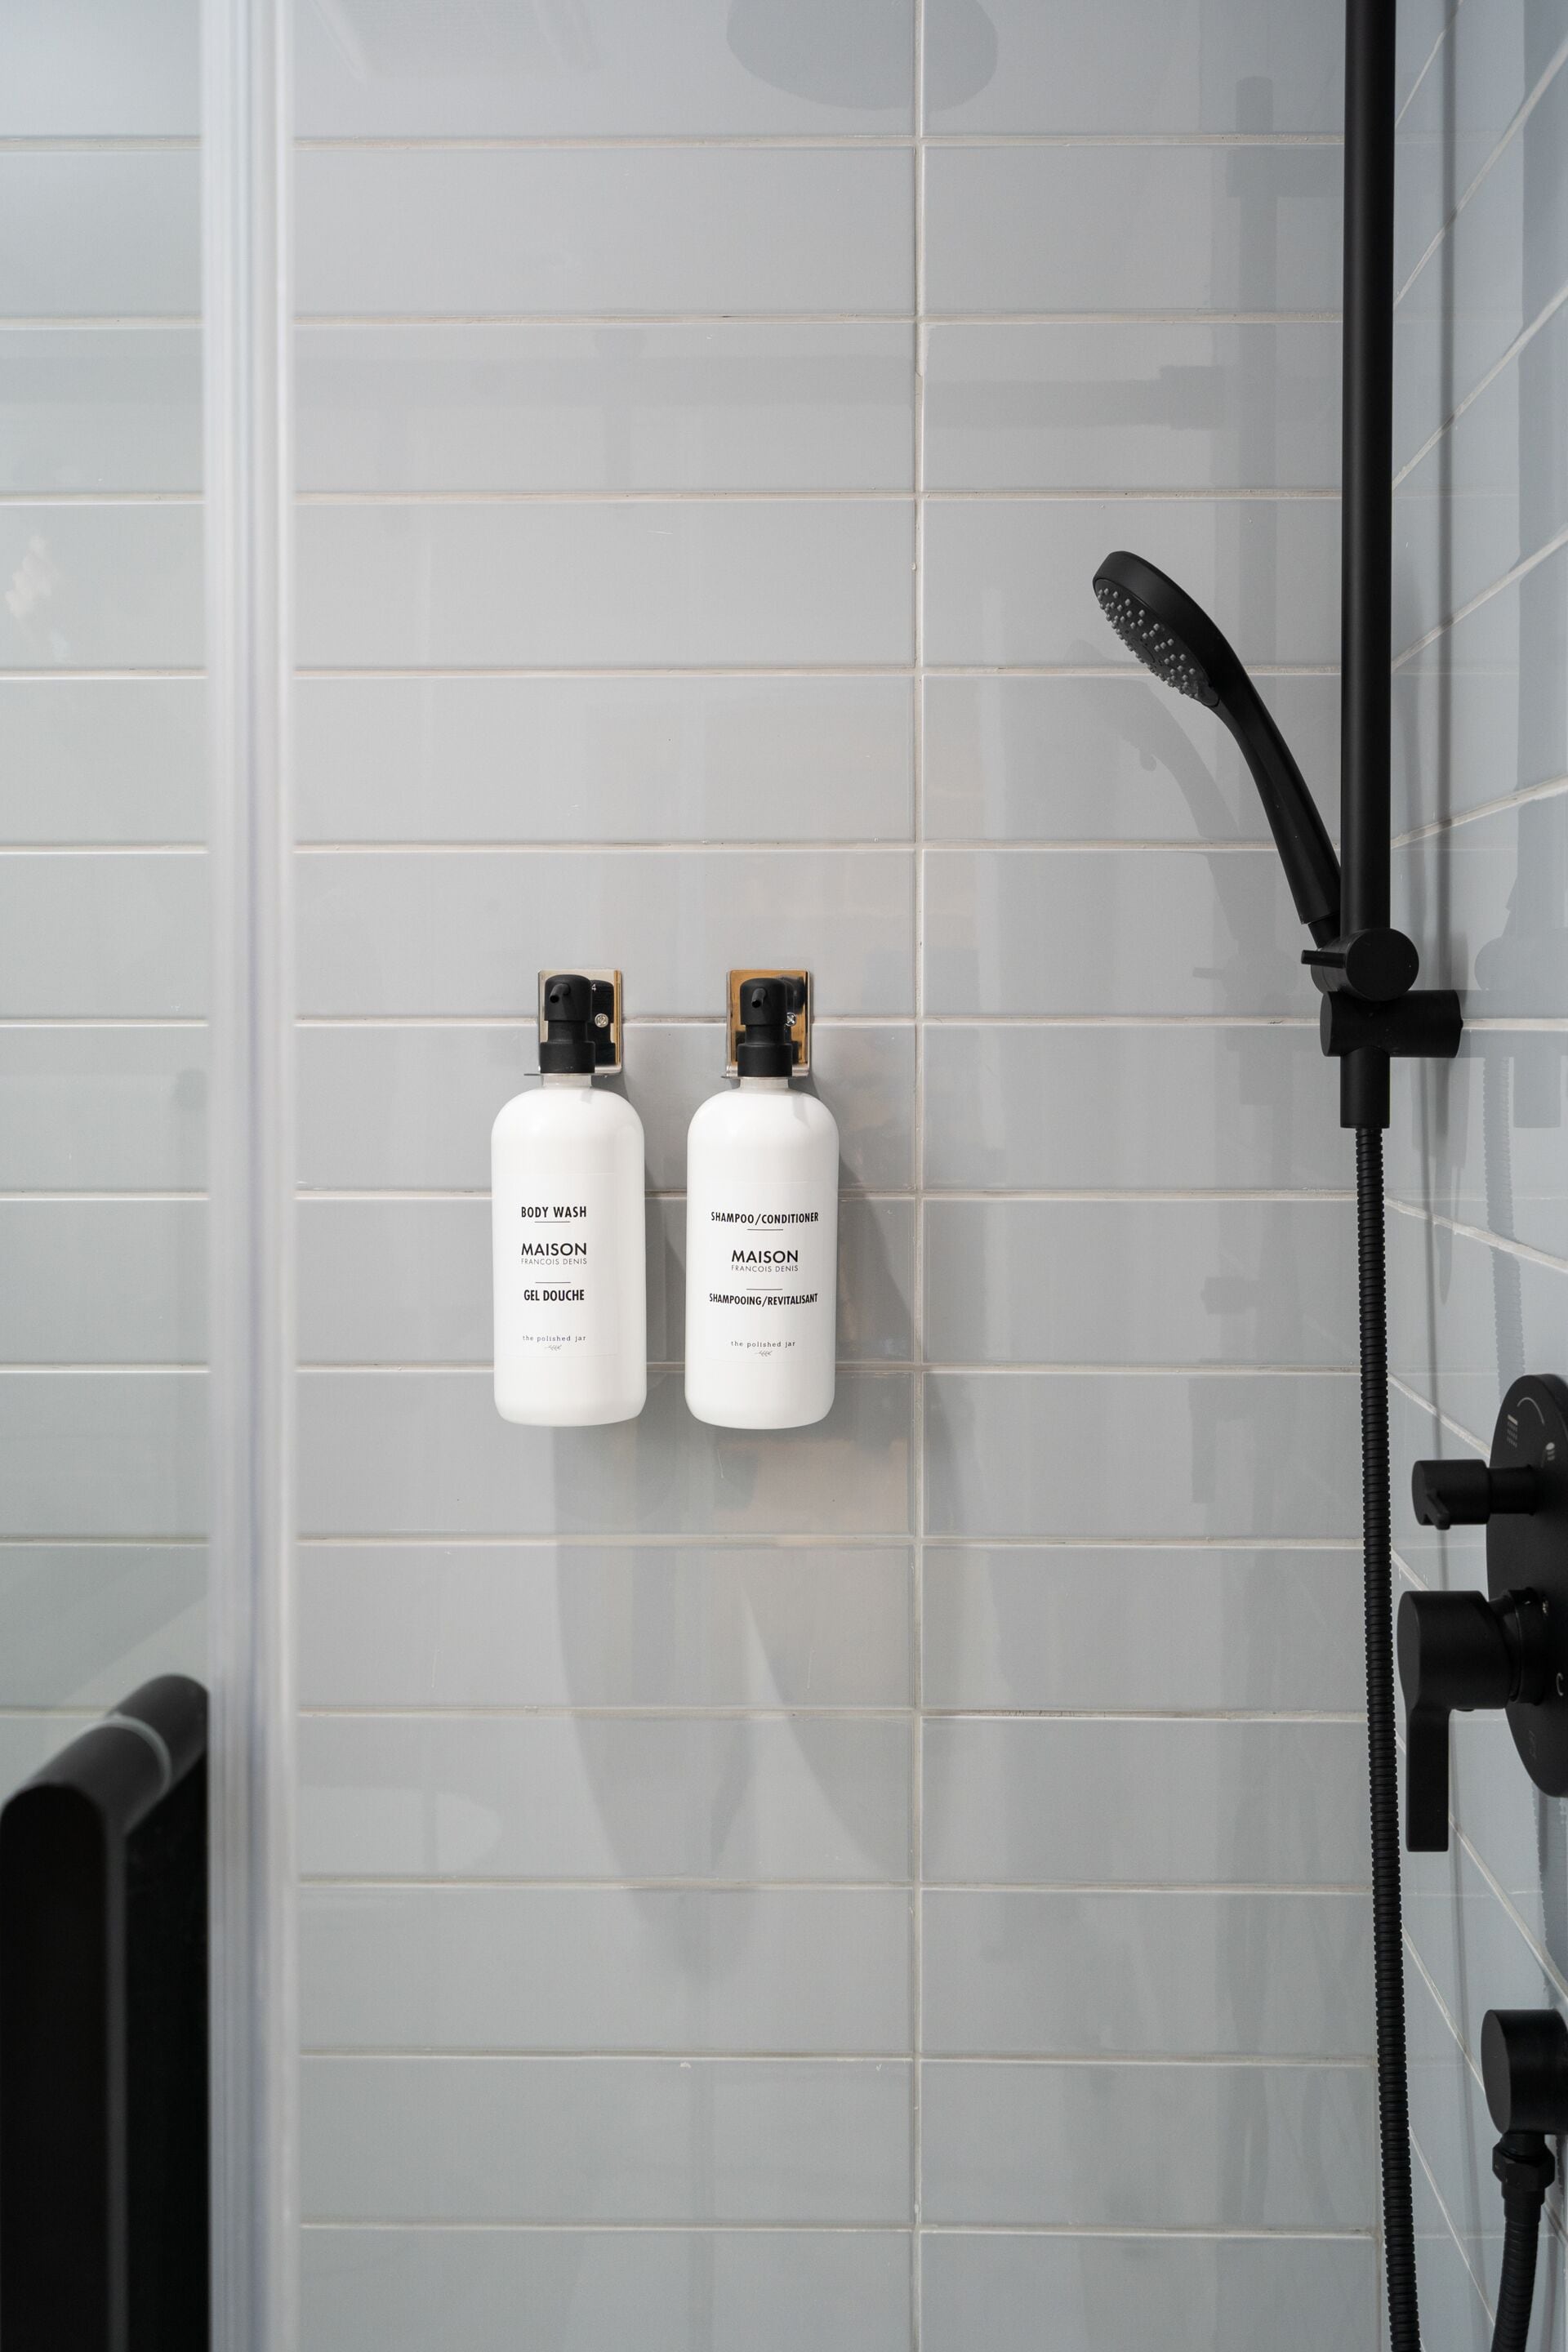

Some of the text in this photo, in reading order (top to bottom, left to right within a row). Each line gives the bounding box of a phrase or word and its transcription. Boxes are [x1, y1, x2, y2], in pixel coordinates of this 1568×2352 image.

[521, 1205, 587, 1218] BODY WASH
[710, 1211, 819, 1226] SHAMPOO/CONDITIONER
[521, 1242, 587, 1256] MAISON
[731, 1250, 799, 1263] MAISON
[775, 1264, 799, 1272] DENIS
[523, 1289, 585, 1301] GEL DOUCHE
[709, 1293, 818, 1307] SHAMPOOING/REVITALISANT
